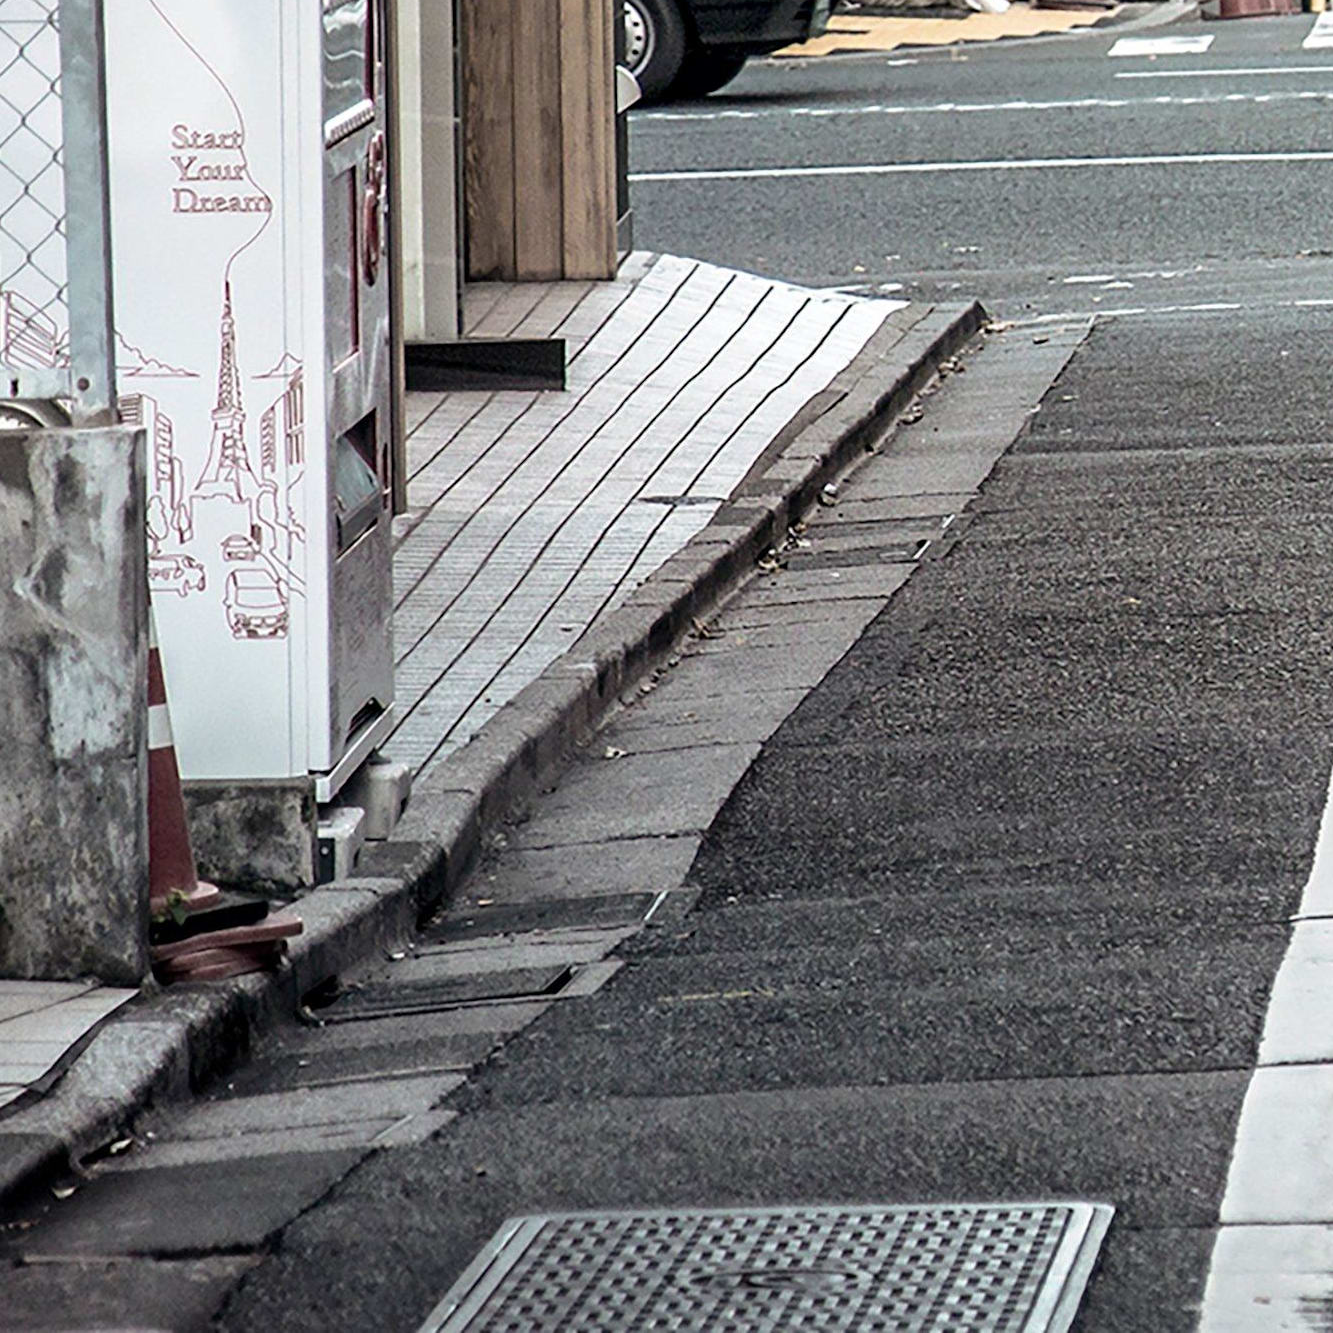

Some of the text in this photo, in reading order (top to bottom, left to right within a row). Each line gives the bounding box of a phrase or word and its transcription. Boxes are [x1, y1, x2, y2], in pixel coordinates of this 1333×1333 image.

[171, 124, 242, 149] Start
[171, 156, 247, 181] Your
[171, 187, 273, 213] Dream
